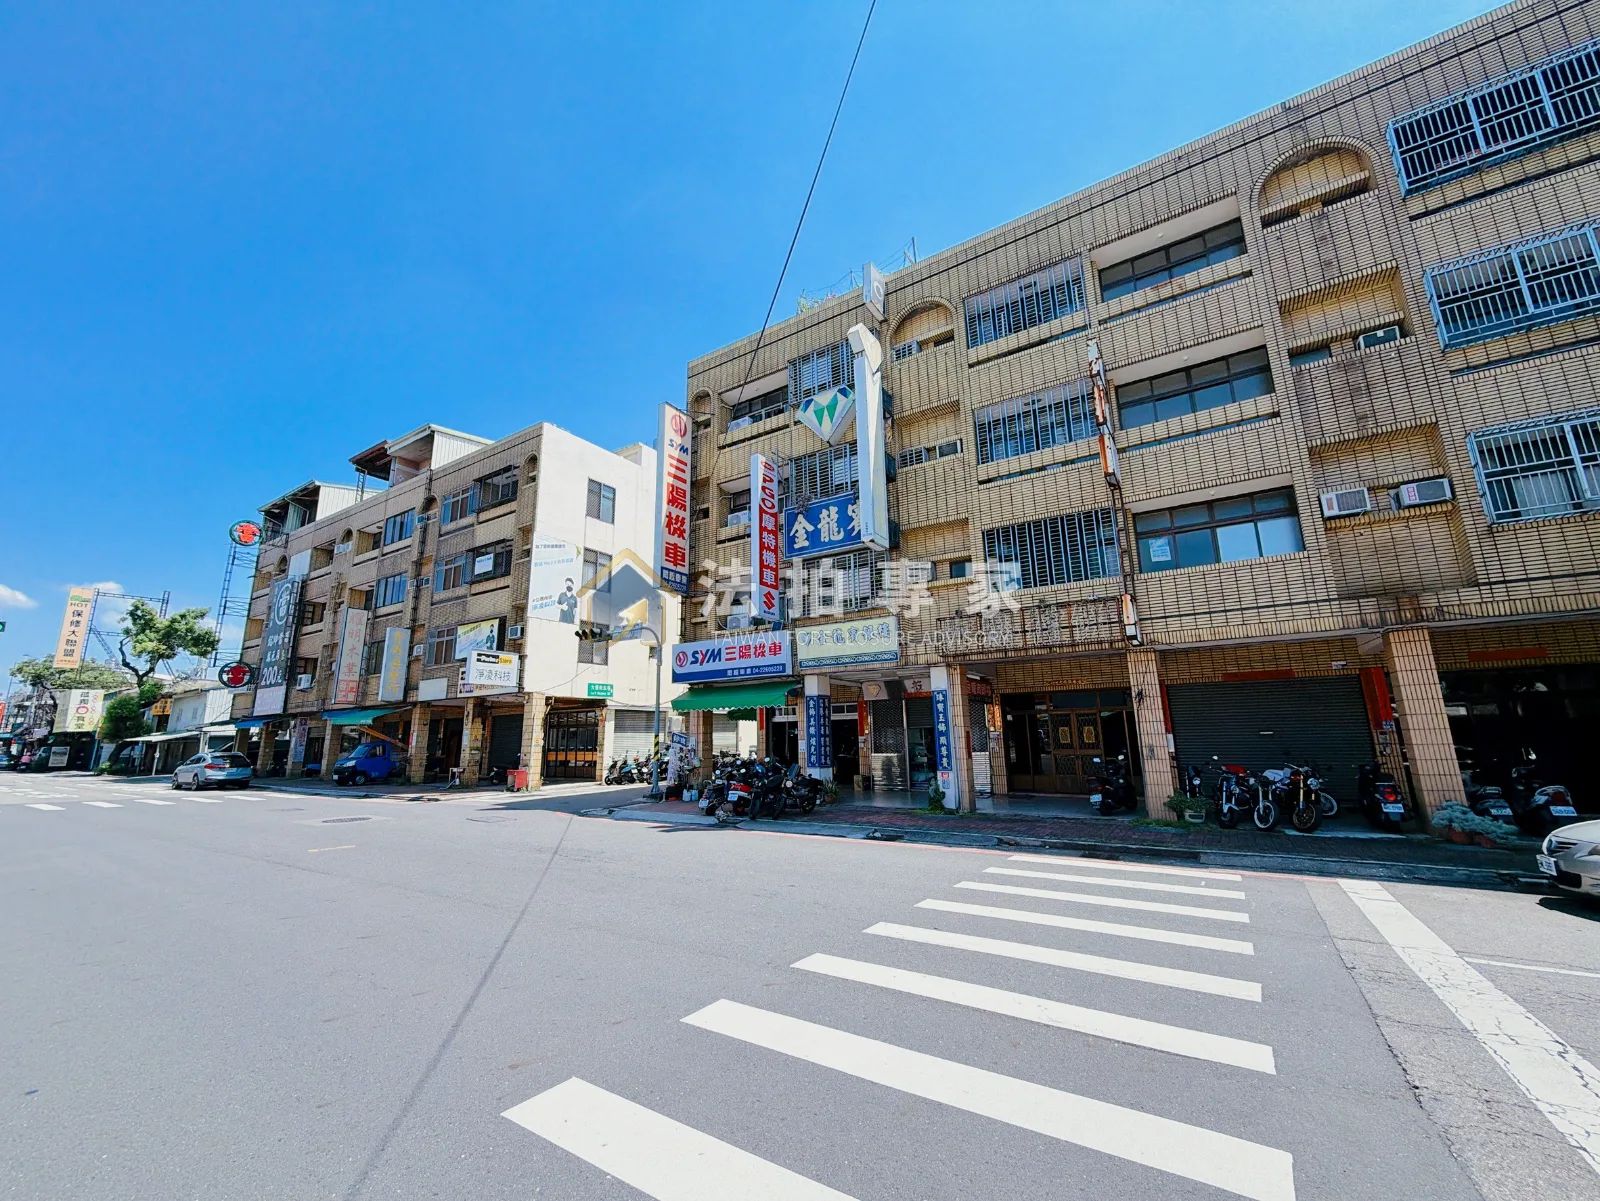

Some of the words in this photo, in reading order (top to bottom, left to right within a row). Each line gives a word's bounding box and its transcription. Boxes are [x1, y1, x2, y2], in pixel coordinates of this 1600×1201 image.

[668, 438, 688, 455] SYM
[664, 453, 688, 568] 三陽機車
[761, 513, 776, 586] 摩特機車
[63, 609, 84, 657] 保修大聯盟
[689, 647, 722, 666] SYM
[724, 641, 783, 662] 三陽機車
[475, 668, 511, 681] 淨凌科技
